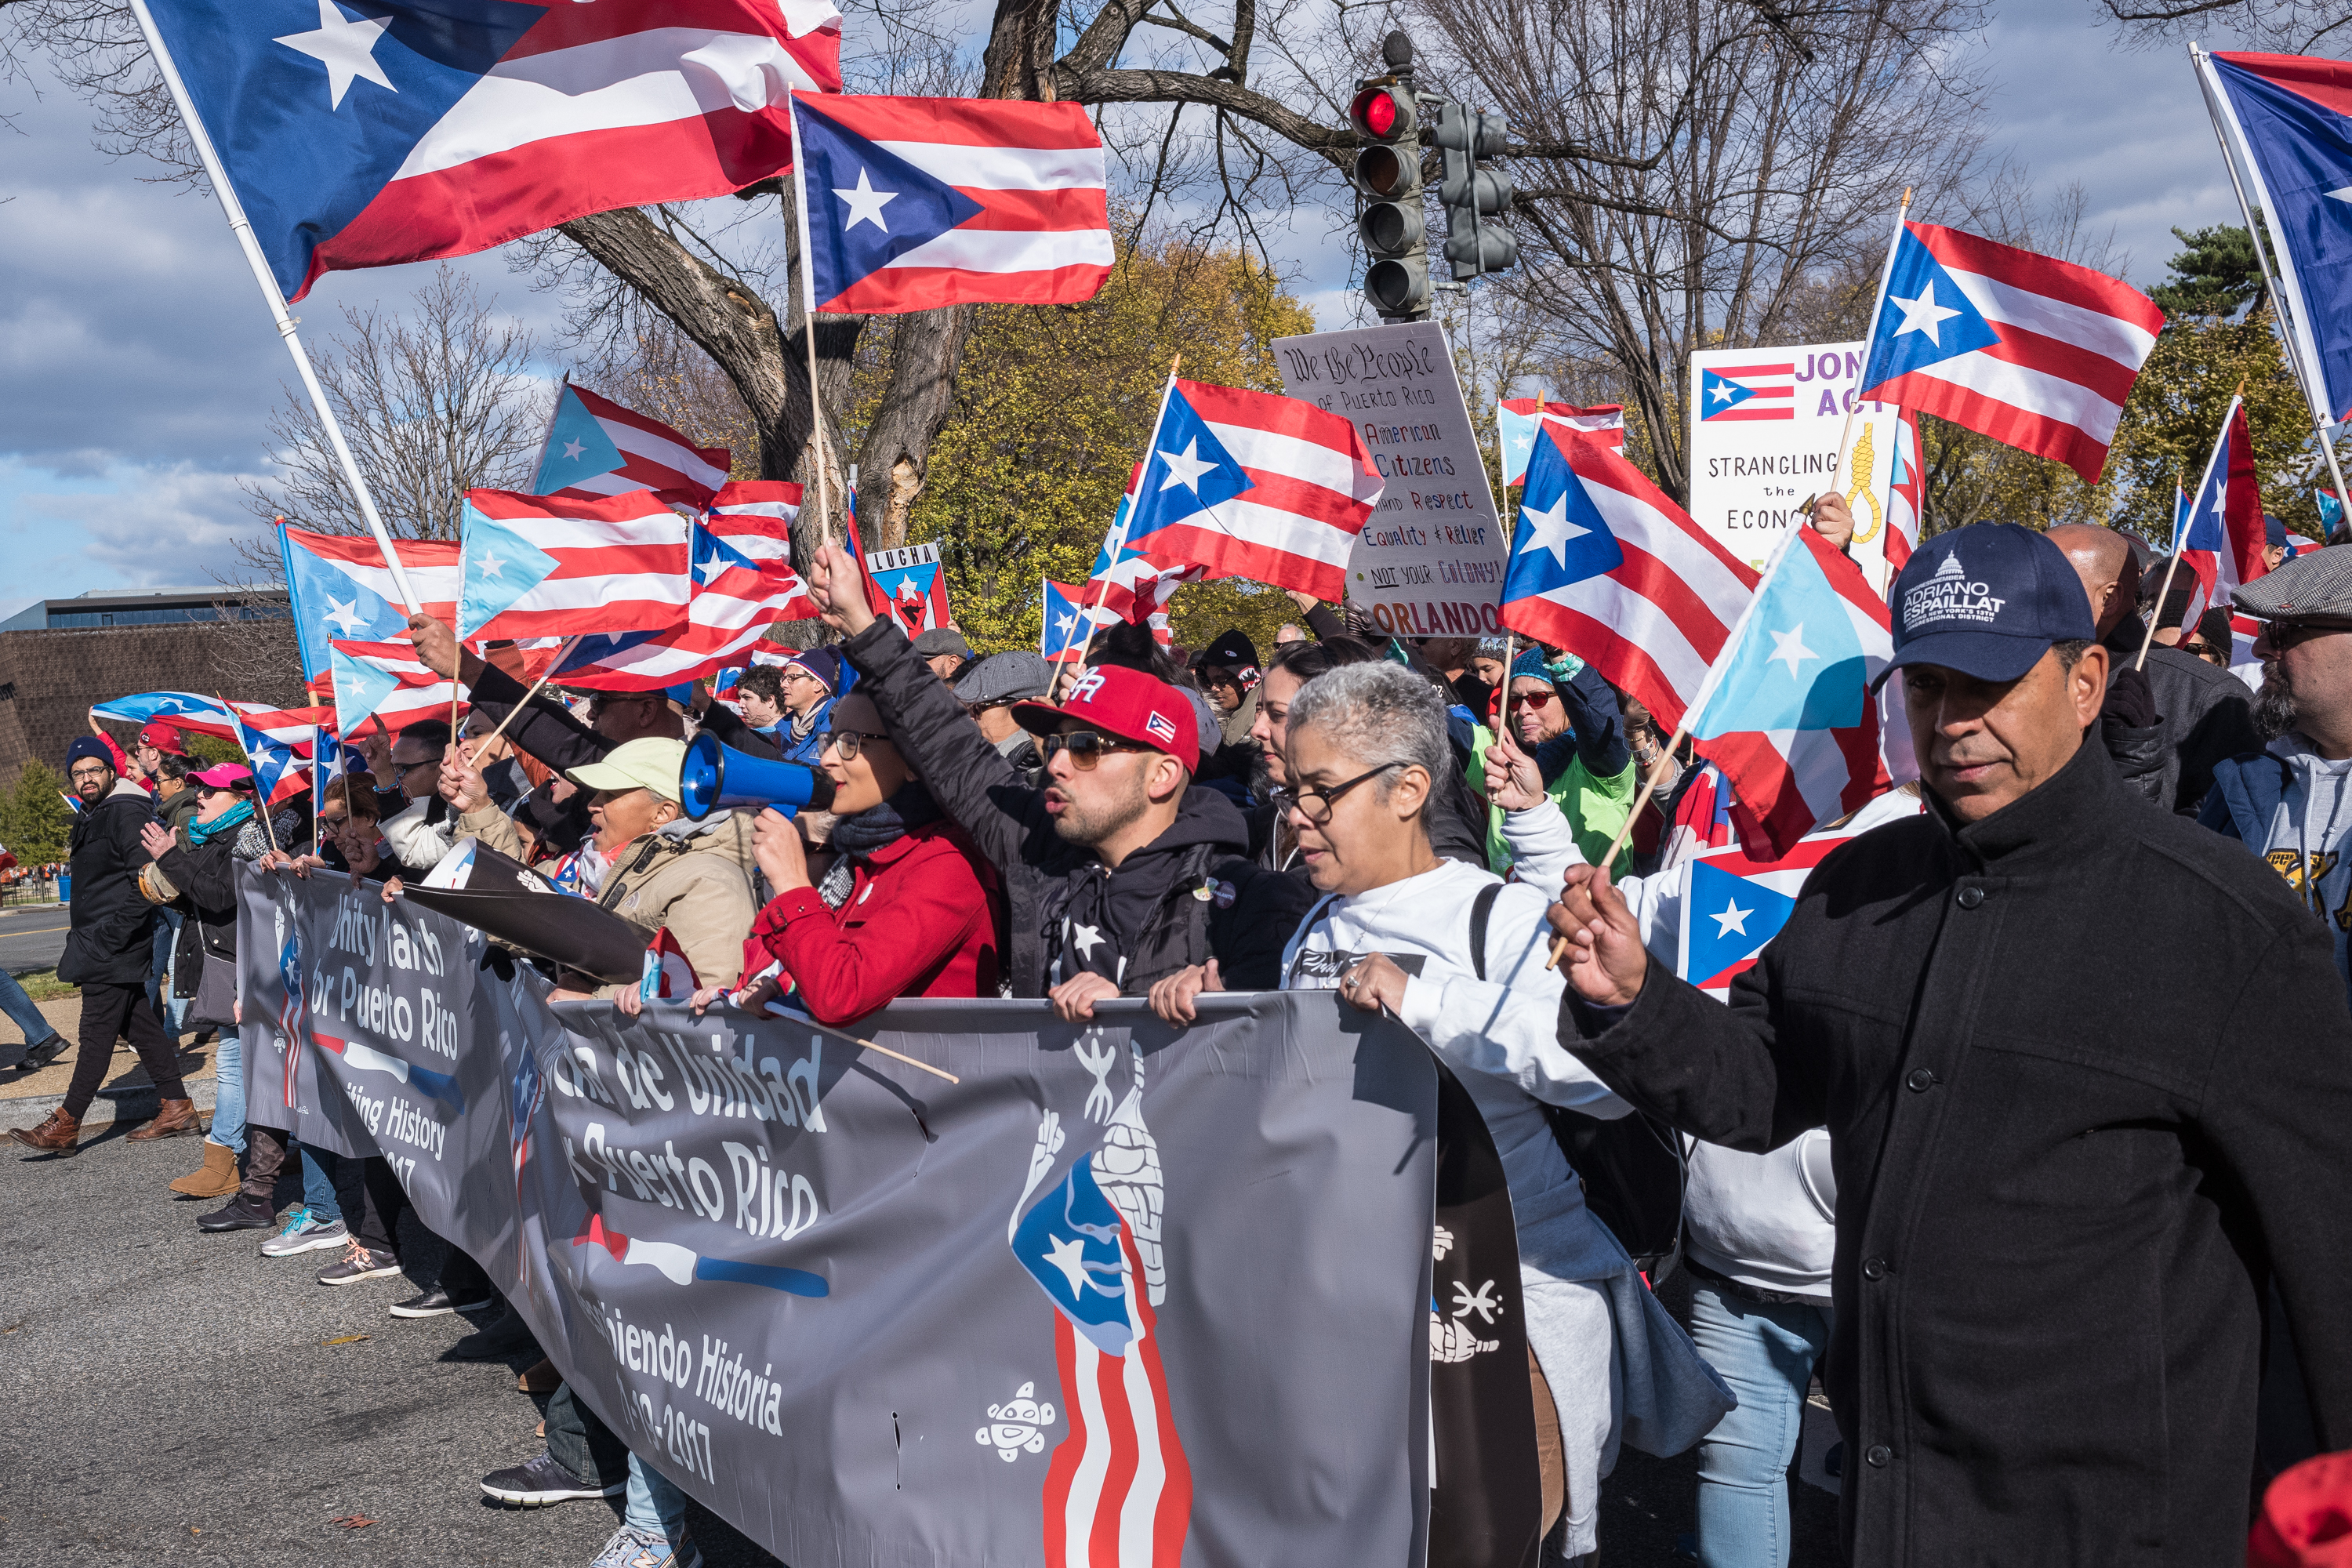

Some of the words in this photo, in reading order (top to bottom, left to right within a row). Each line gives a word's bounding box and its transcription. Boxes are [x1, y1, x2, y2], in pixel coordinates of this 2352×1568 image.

[1284, 348, 1321, 382] We
[1324, 347, 1358, 385] the
[1351, 339, 1435, 384] People
[1795, 350, 1864, 382] JON
[1318, 394, 1332, 411] of
[1364, 423, 1442, 445] American
[1374, 454, 1456, 477] Citizens
[1708, 452, 1838, 477] STRANGLING
[1763, 487, 1795, 496] the
[874, 546, 932, 570] LUCHA
[1370, 567, 1396, 586] NOT
[1401, 564, 1434, 586] YOUR
[1905, 575, 1965, 596] CONGRESSMEMBER
[1904, 582, 1989, 610] ADRIANO
[1373, 601, 1503, 635] ORLANDO
[1904, 595, 2005, 624] ESPAILLAT
[1906, 613, 1927, 626] SERVING
[1905, 614, 1955, 633] CONGRESSIONAL
[1958, 613, 1994, 622] DISTRICT
[340, 965, 412, 1042] Puerto
[421, 987, 457, 1061] Rico
[615, 1031, 674, 1112] de
[659, 1033, 827, 1133] Unidad
[385, 1096, 445, 1161] History
[583, 1122, 724, 1222] Puerto
[722, 1141, 818, 1241] Rico
[695, 1334, 782, 1437] Historia
